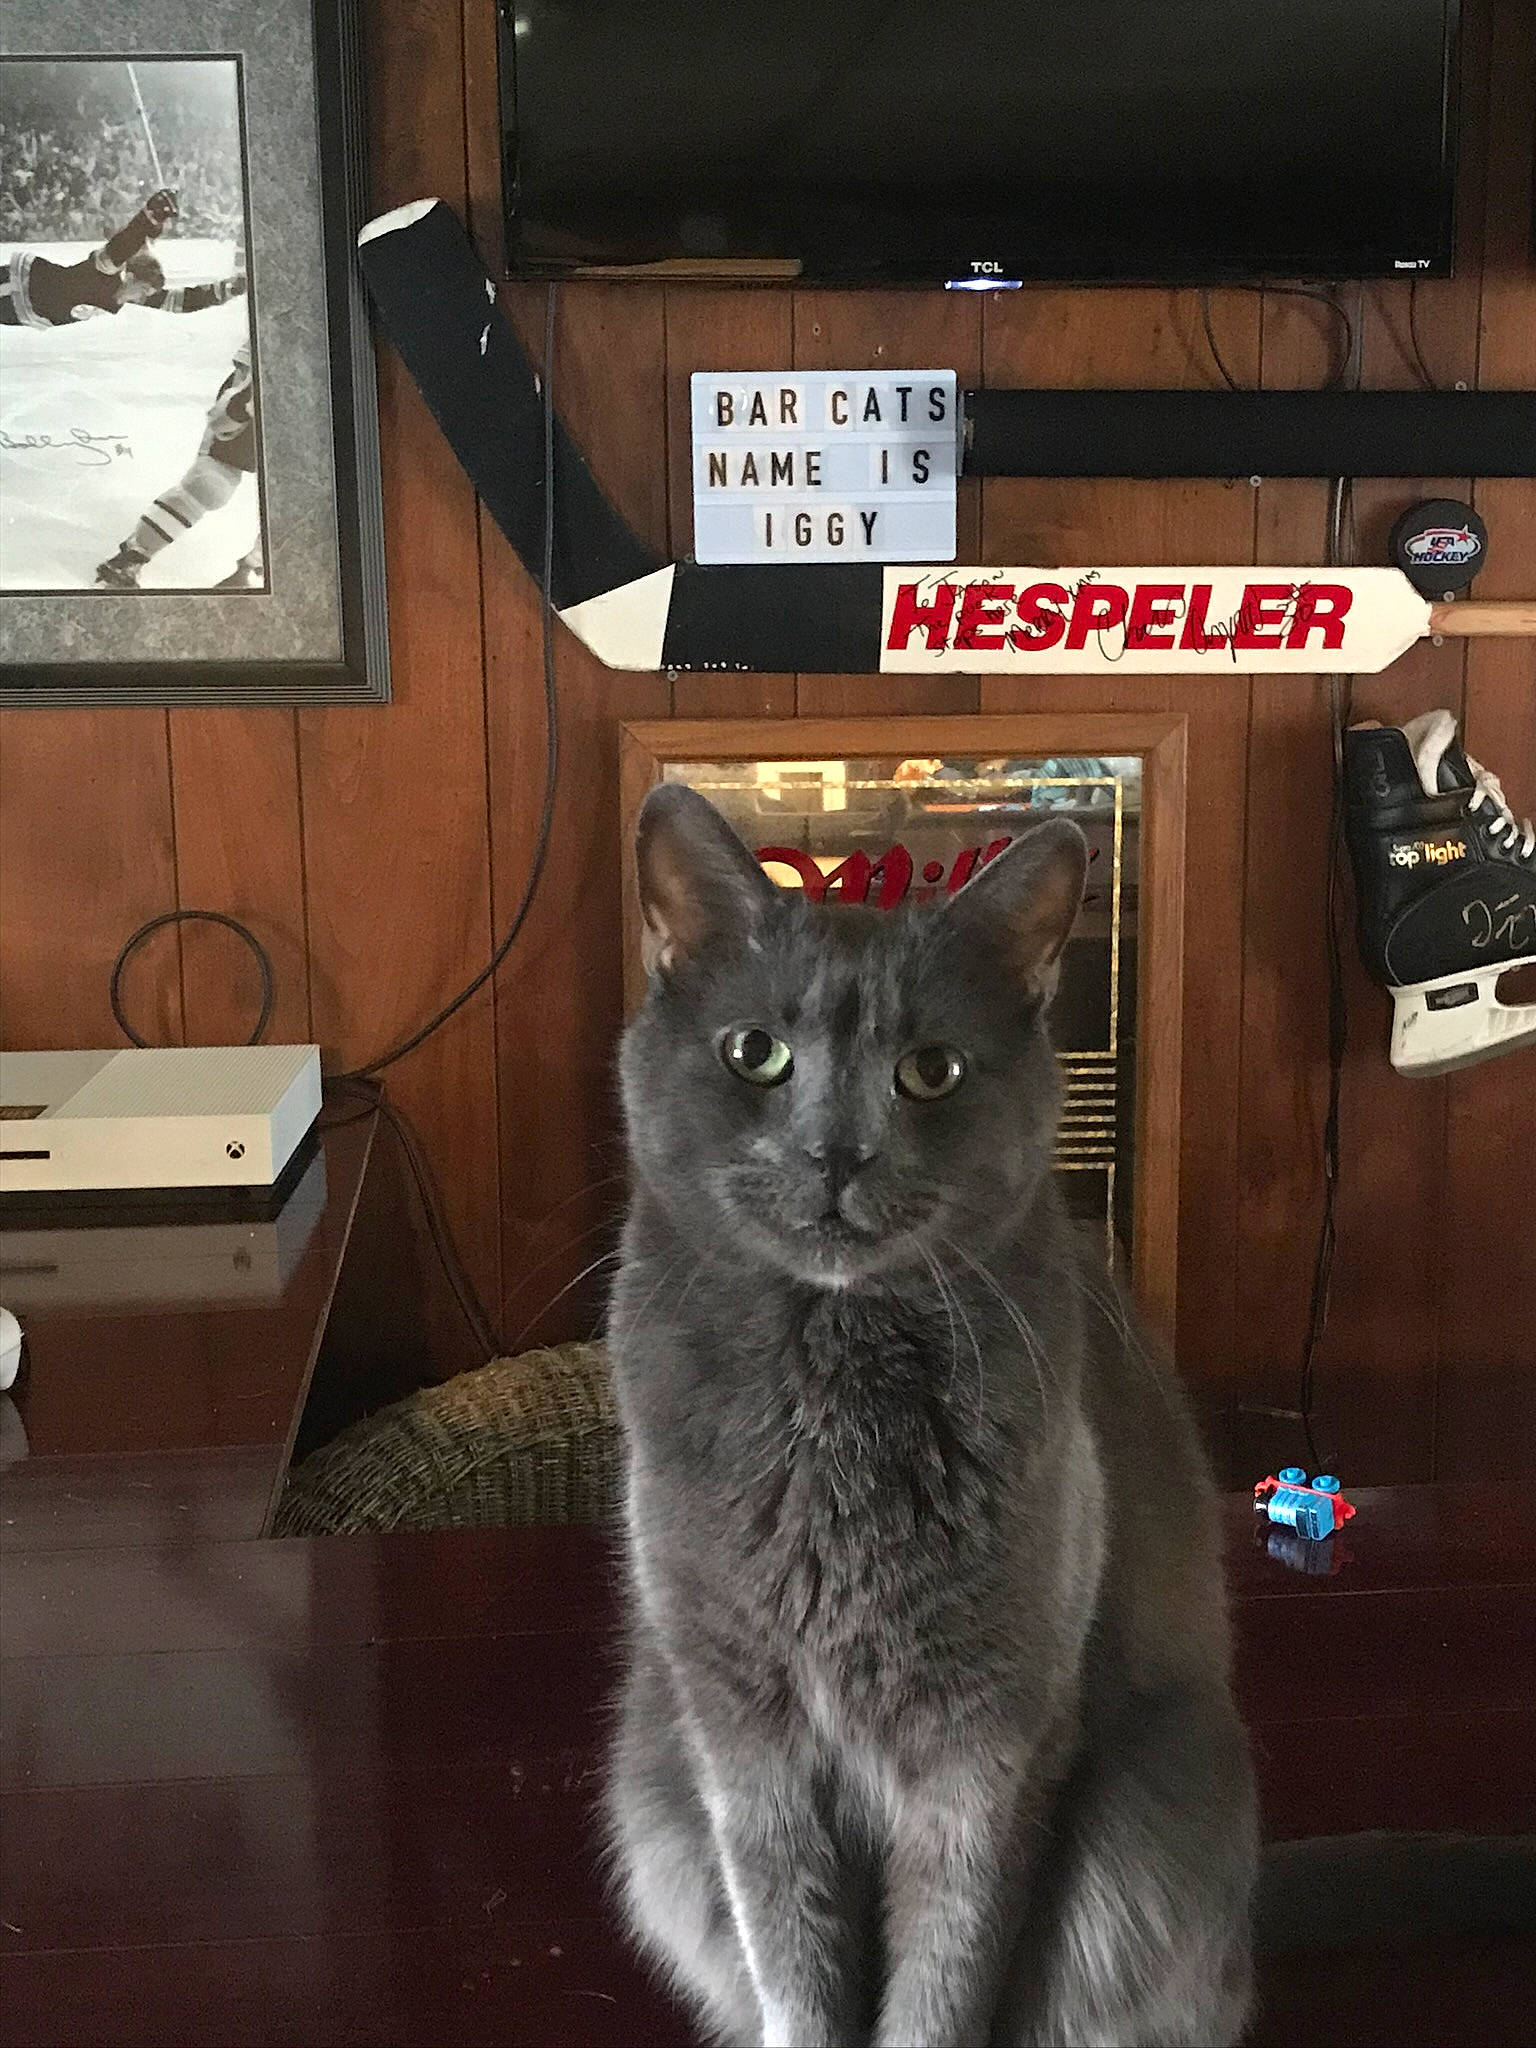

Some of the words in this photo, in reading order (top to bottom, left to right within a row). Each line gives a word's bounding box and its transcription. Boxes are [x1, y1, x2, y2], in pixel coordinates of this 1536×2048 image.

[971, 261, 1003, 273] TCL
[1417, 260, 1431, 268] TV
[716, 388, 798, 427] BAR
[831, 387, 946, 426] CATS
[708, 450, 823, 488] NAME
[881, 450, 931, 484] IS
[765, 511, 878, 547] IGGY
[1413, 551, 1468, 562] HOCKEY
[886, 583, 1353, 652] HESPELER
[1425, 841, 1467, 865] light
